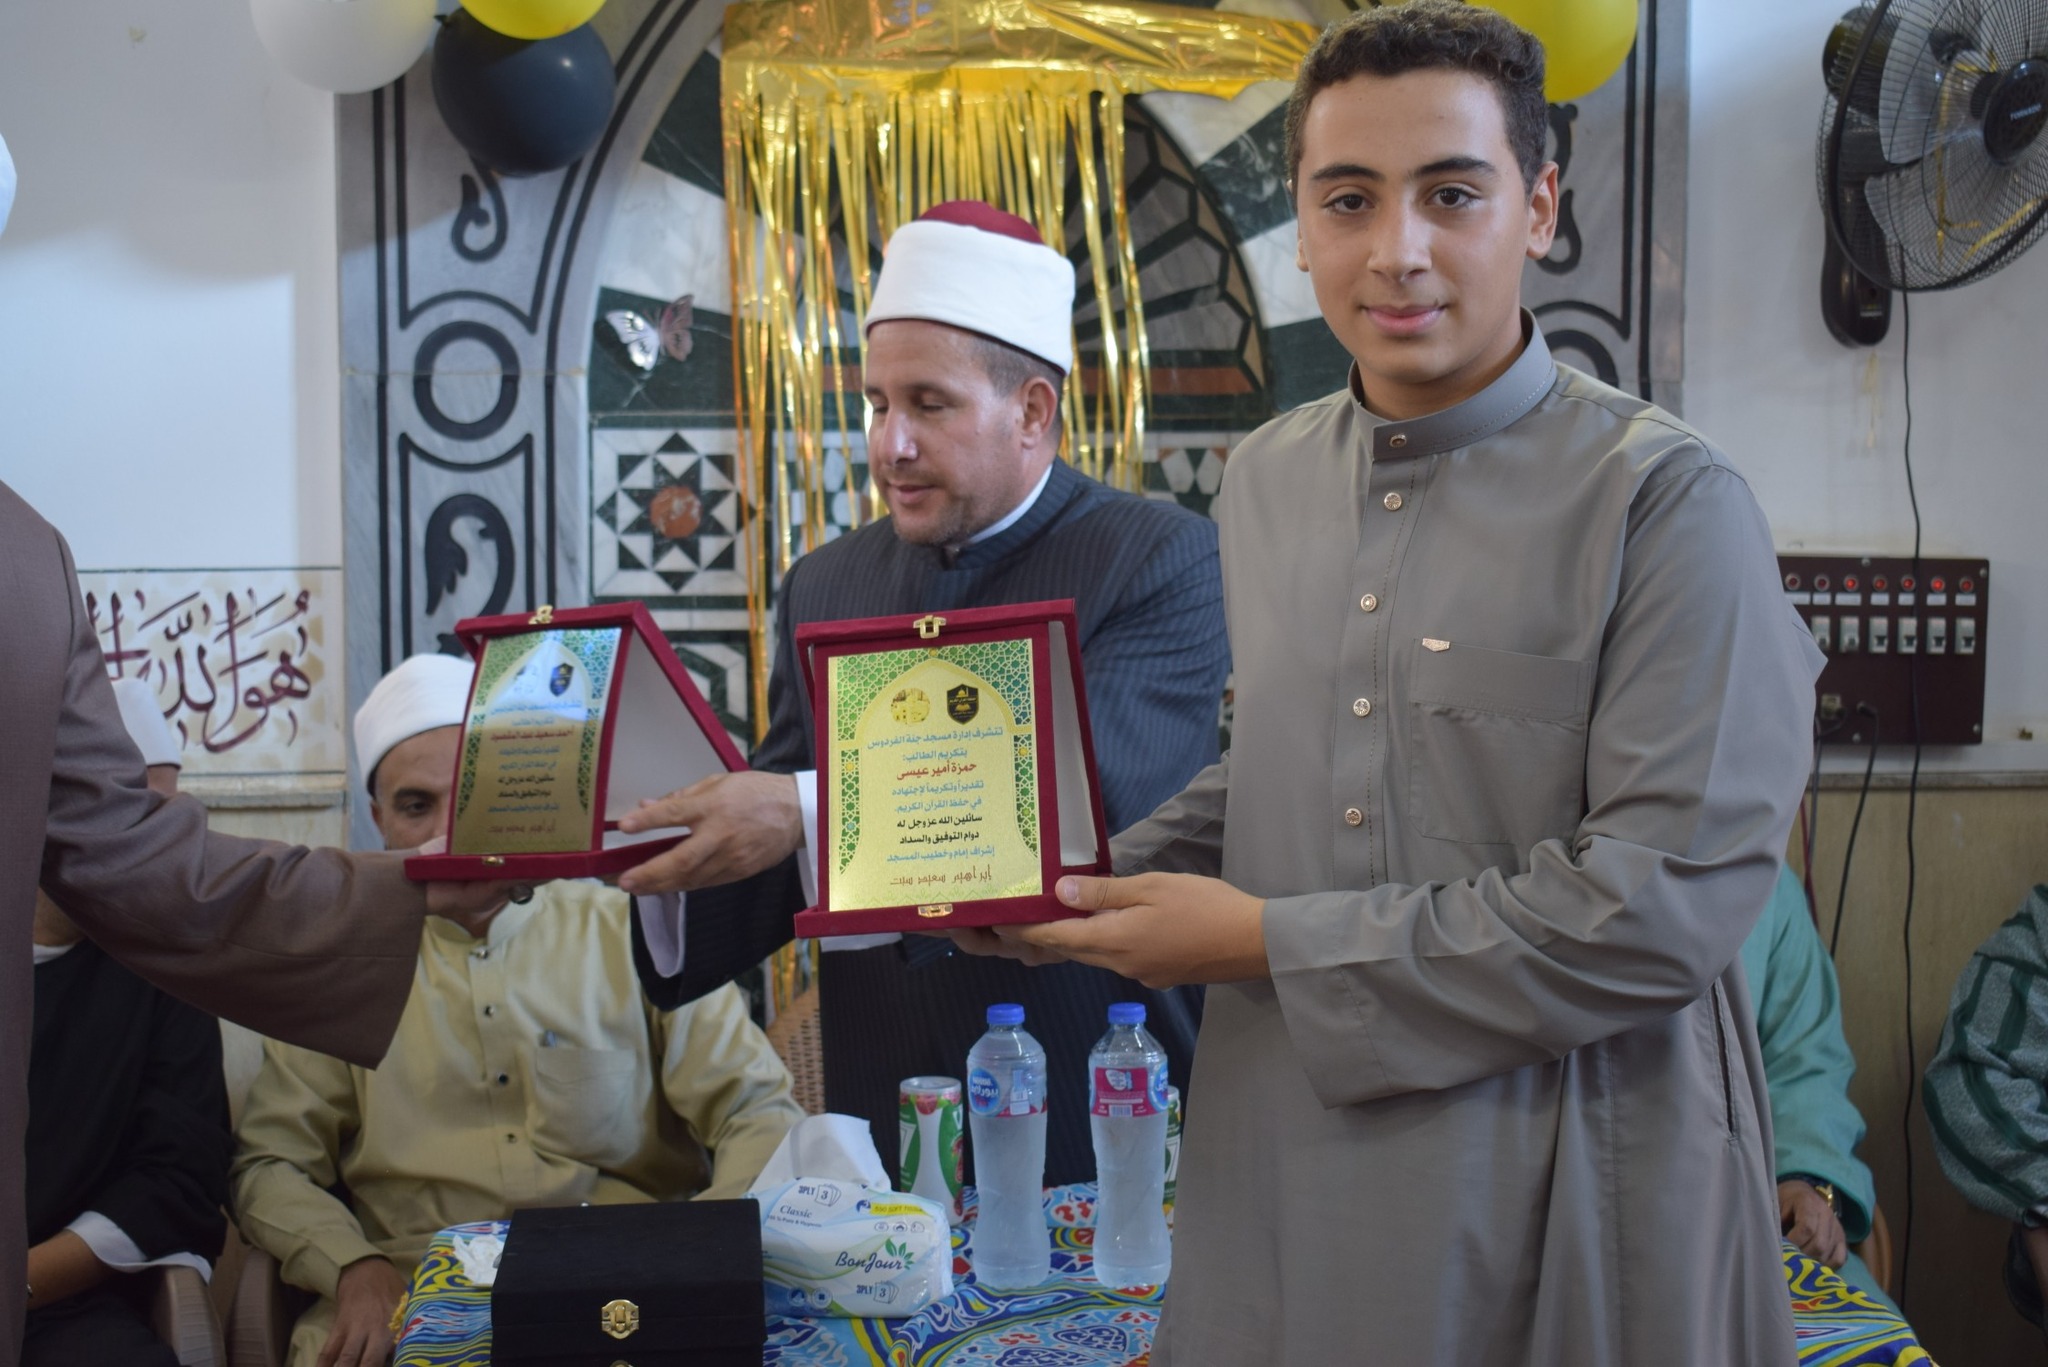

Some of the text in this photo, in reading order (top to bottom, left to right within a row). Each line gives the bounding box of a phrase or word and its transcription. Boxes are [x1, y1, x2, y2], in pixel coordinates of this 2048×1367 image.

[867, 727, 1003, 749] تتشرف إدارة مسجد جنة الفردوس
[938, 748, 968, 760] بتكريم
[897, 760, 977, 780] حمزة أمير عيسى
[949, 799, 969, 808] حفظ
[970, 796, 982, 810] في
[897, 820, 905, 828] له
[939, 816, 952, 825] الله
[953, 813, 982, 826] سائلين
[900, 831, 979, 844] دوام التوفيق والسداد
[887, 851, 919, 863] المسجد
[953, 848, 968, 859] إمام
[970, 845, 995, 857] إشراف
[952, 864, 992, 884] إبراهيم
[918, 874, 946, 887] سعيد
[821, 1190, 828, 1200] 3
[780, 1205, 812, 1218] Classic
[835, 1251, 902, 1273] BonJour
[879, 1288, 887, 1298] 3
